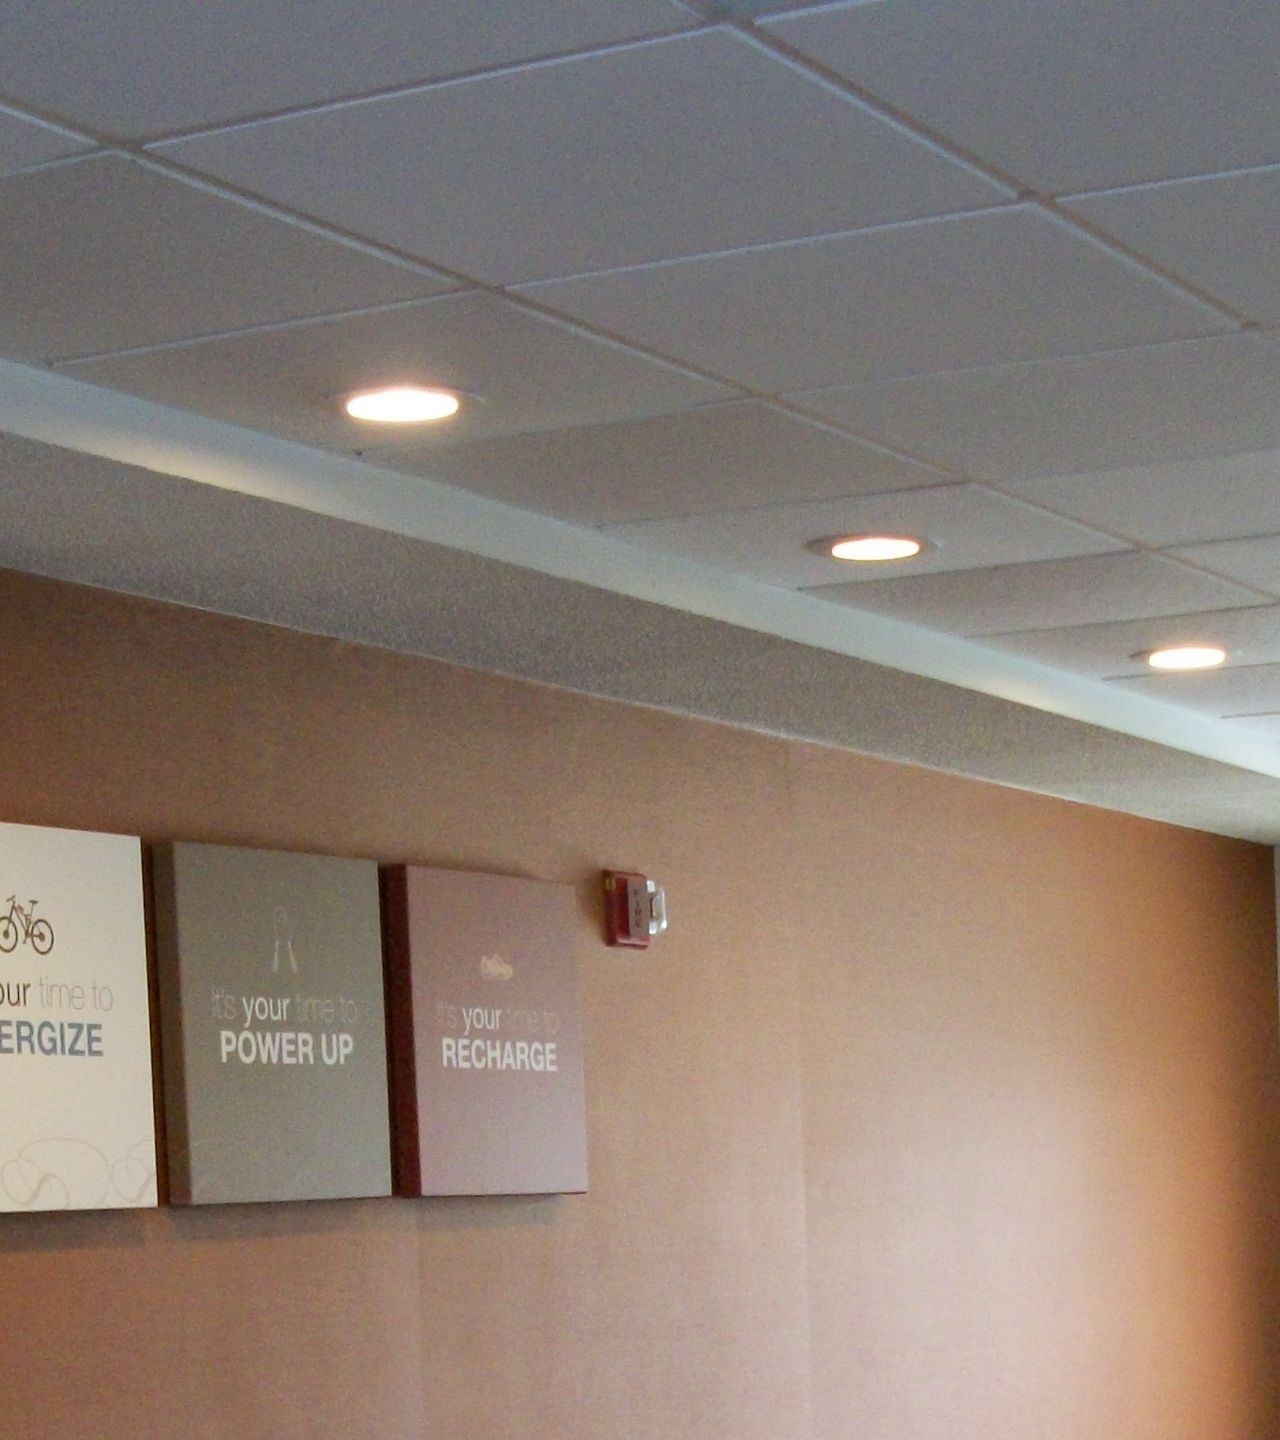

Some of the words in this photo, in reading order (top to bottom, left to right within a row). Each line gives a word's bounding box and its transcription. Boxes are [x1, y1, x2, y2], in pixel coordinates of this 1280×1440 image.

[38, 975, 86, 1010] time
[93, 981, 114, 1012] to
[242, 996, 291, 1028] your
[462, 1006, 503, 1036] your
[220, 1029, 315, 1065] POWER
[321, 1032, 354, 1066] UP
[441, 1037, 559, 1072] RECHARGE
